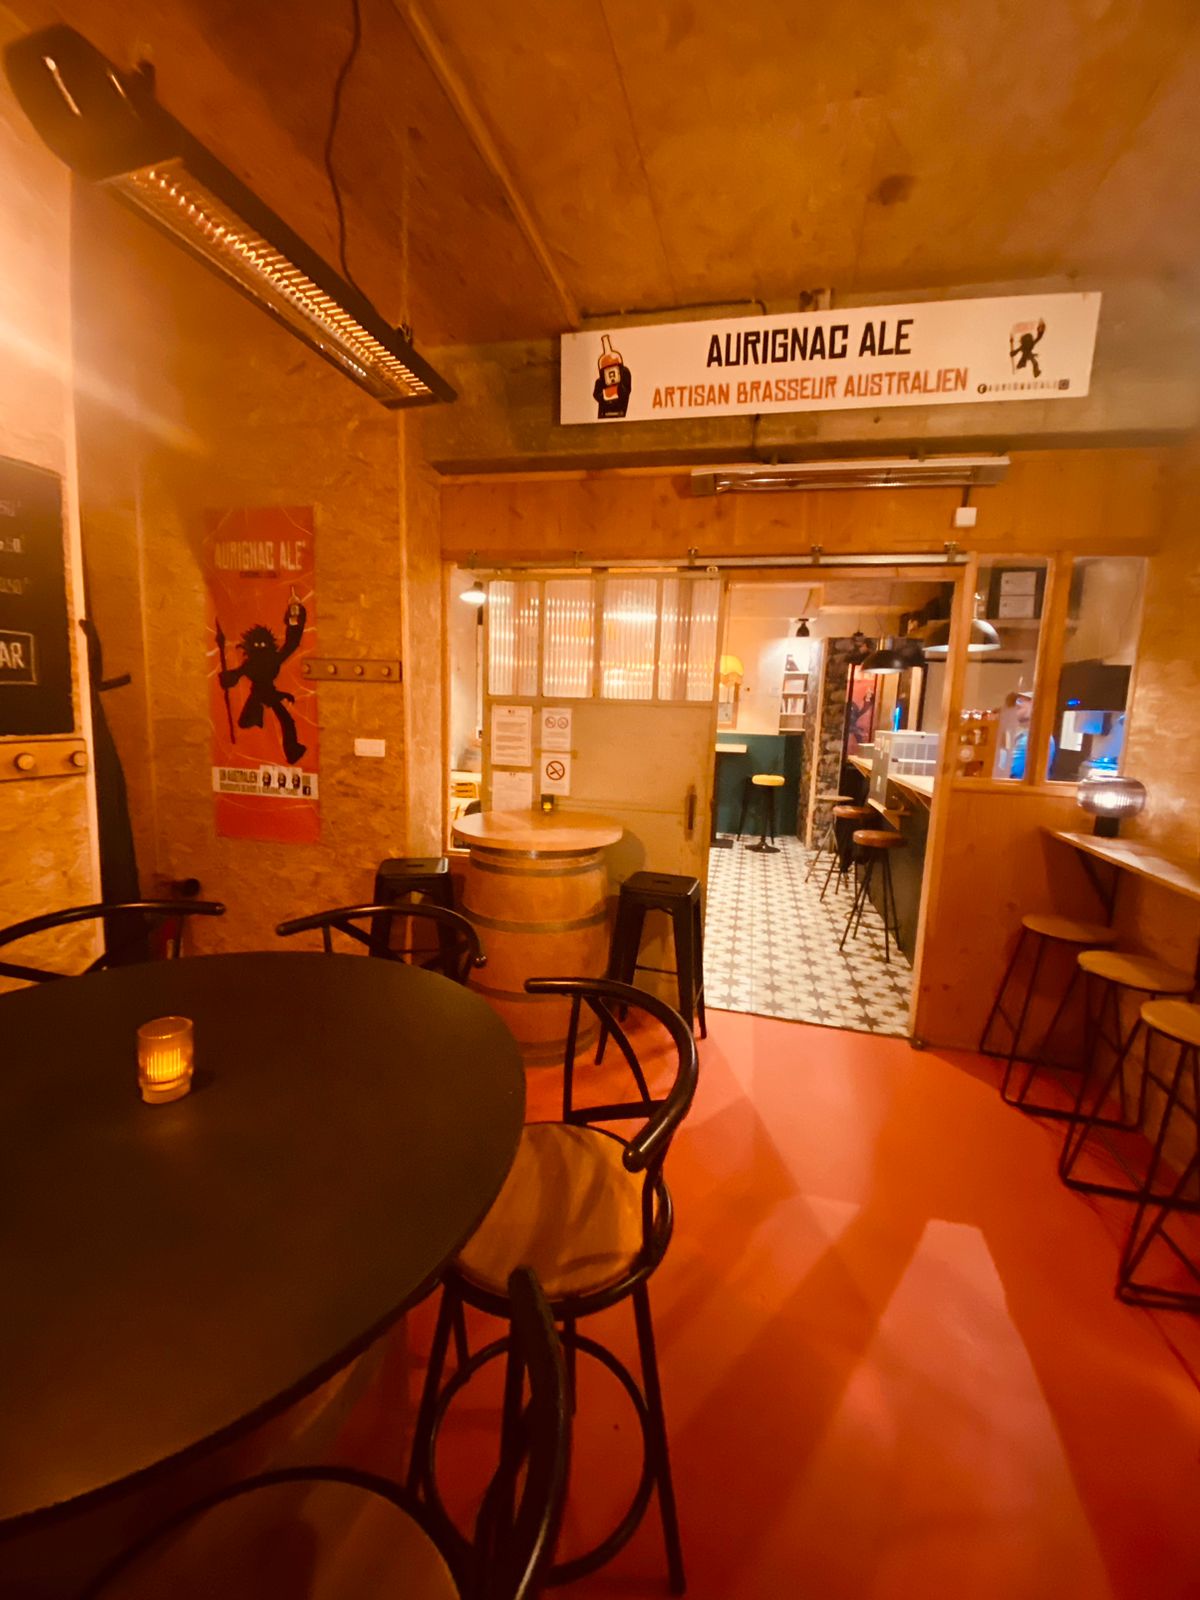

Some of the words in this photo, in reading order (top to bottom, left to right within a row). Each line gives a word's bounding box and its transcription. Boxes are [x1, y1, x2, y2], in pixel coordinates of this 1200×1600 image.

[706, 324, 849, 367] AURIGNAC
[858, 319, 914, 357] ALE
[652, 383, 730, 409] ARTISAN
[736, 375, 838, 404] BRASSEUR
[844, 367, 969, 397] AUSTRALIEN
[214, 541, 274, 570] AURIGNAC
[280, 541, 303, 570] ALE
